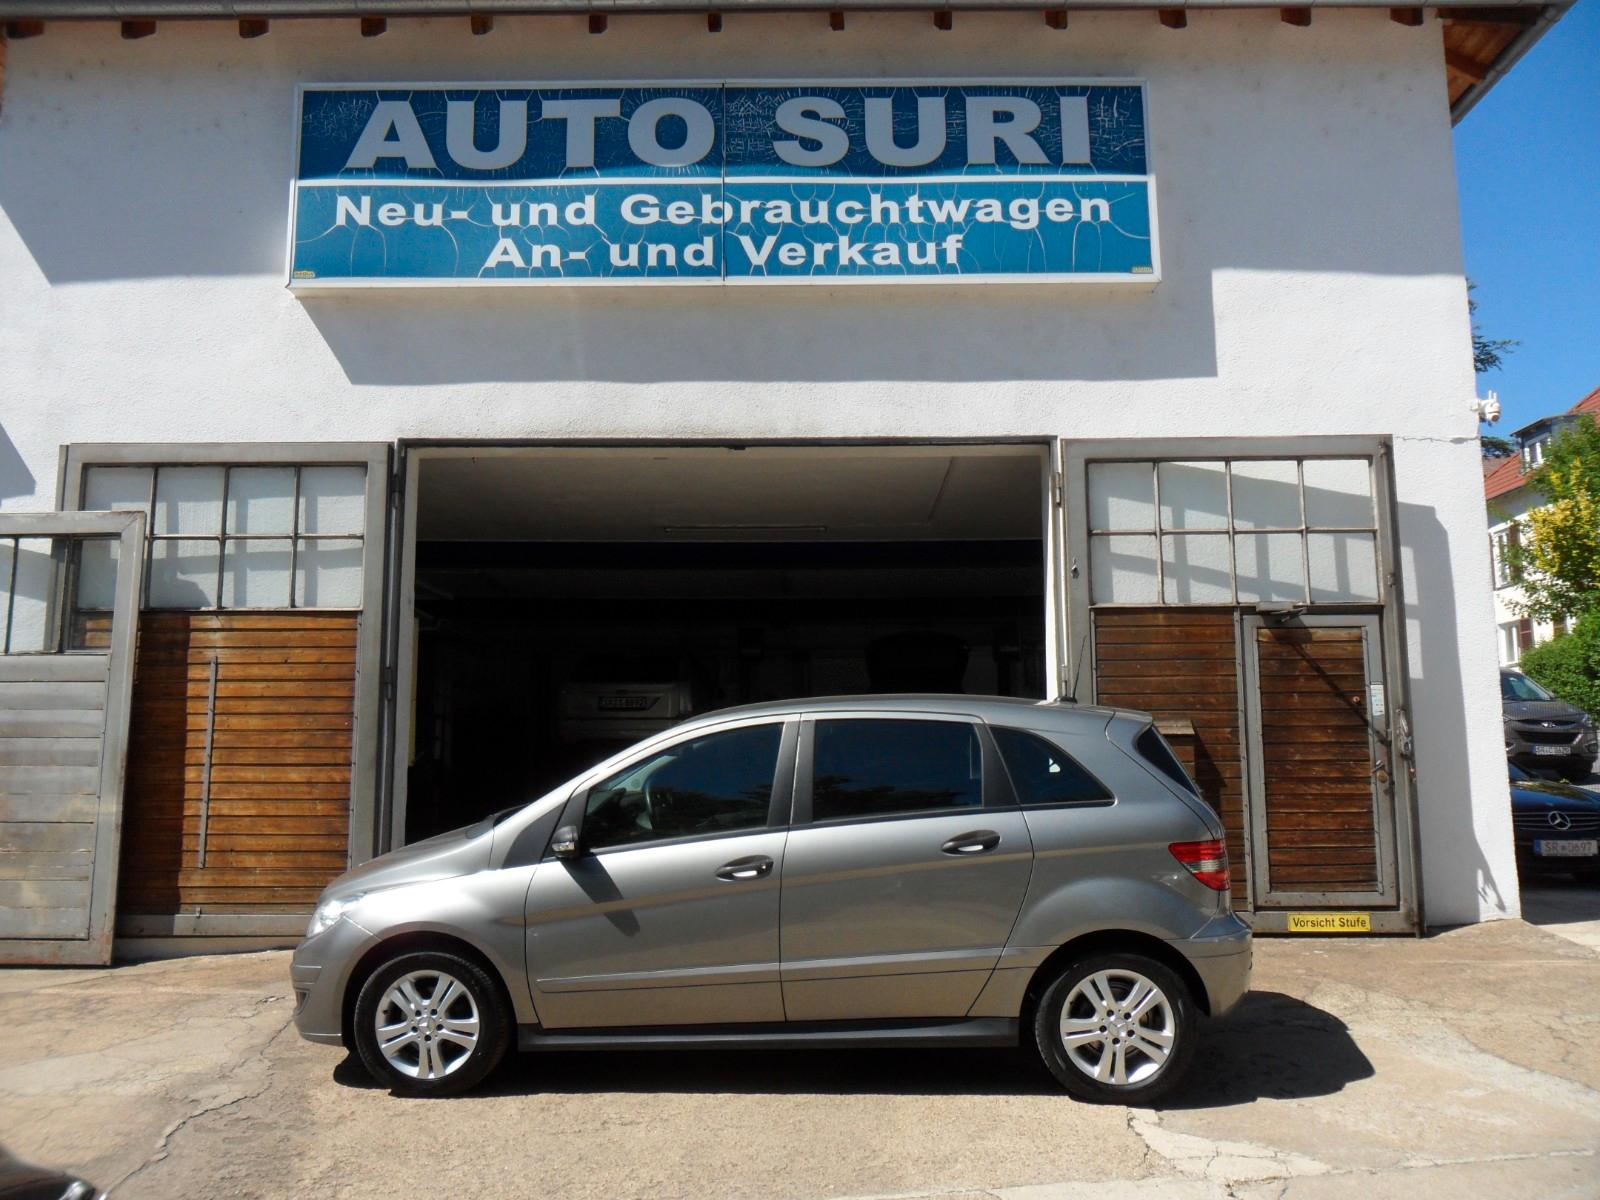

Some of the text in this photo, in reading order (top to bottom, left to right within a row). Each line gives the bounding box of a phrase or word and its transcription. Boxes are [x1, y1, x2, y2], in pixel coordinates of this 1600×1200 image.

[345, 96, 1093, 170] AUTO SURI
[335, 193, 1110, 231] Neu- und Gebrauchtwagen
[484, 233, 964, 269] An- und Verkauf
[1292, 916, 1367, 928] Vorsicht Stufe
